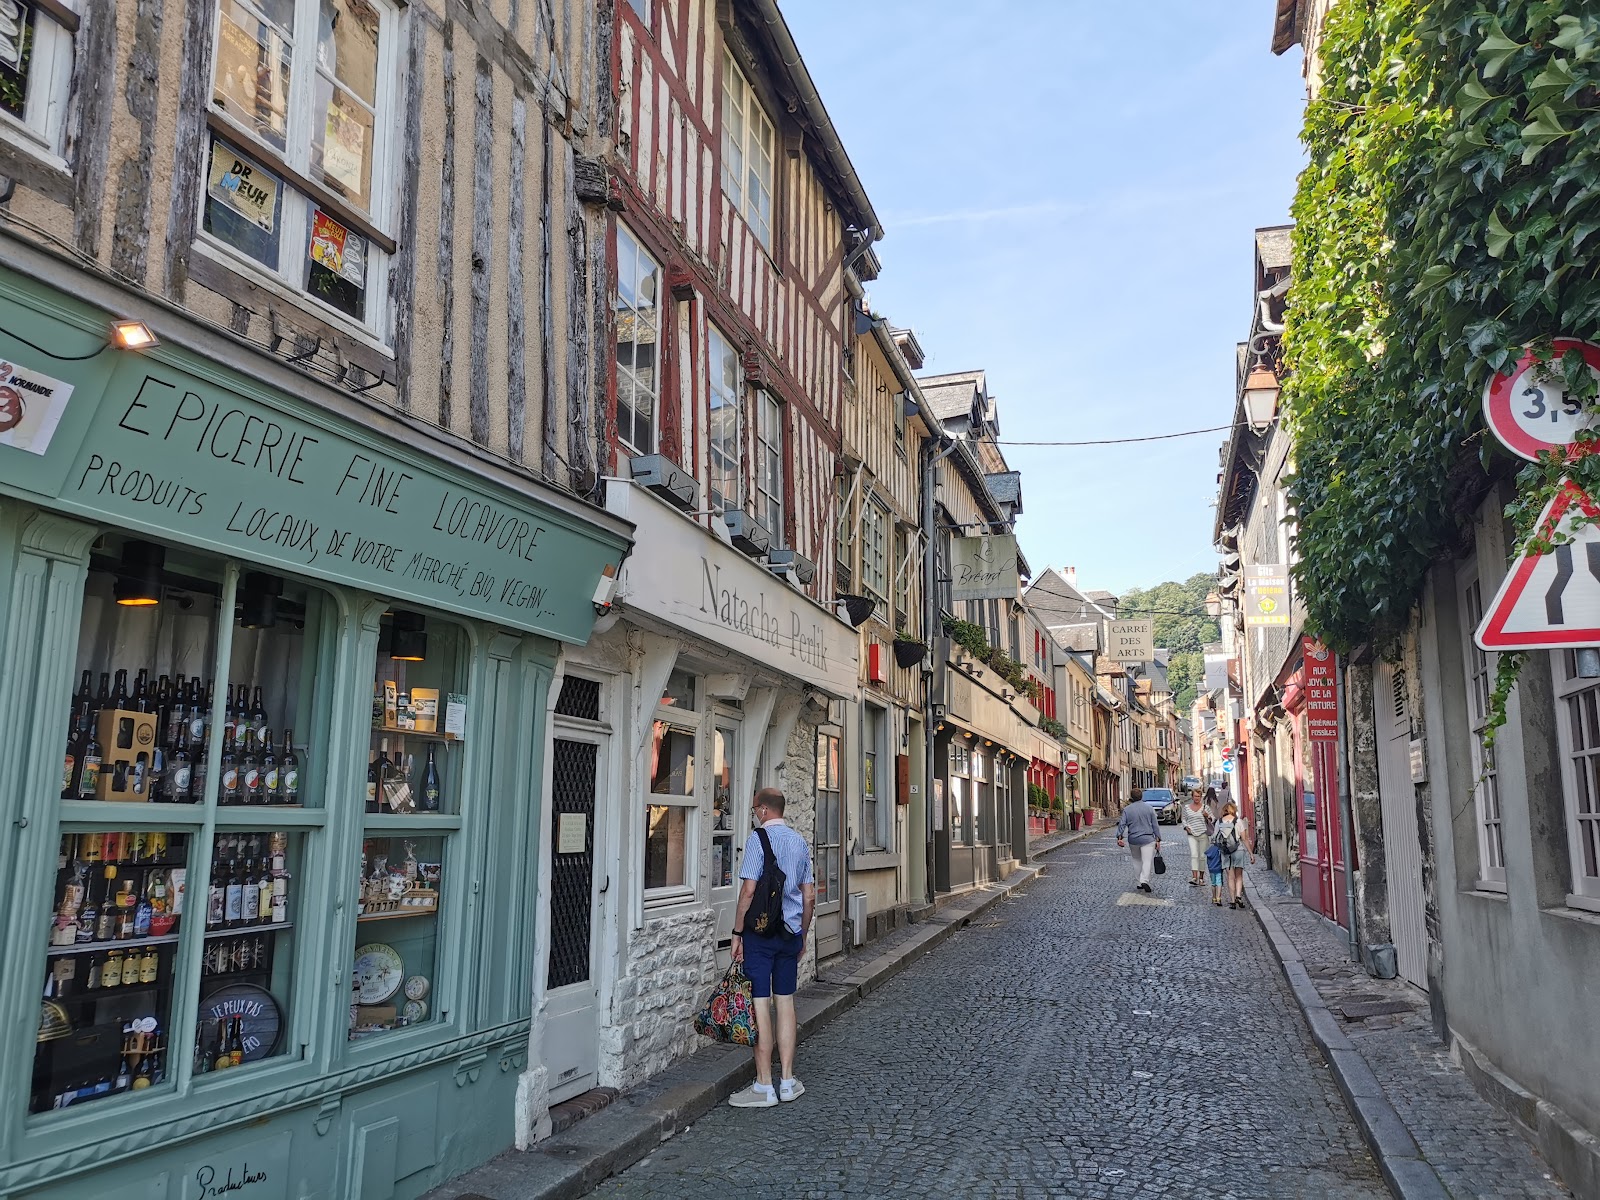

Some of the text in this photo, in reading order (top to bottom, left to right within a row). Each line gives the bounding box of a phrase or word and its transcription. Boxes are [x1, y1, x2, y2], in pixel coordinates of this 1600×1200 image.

[231, 160, 252, 179] DR
[220, 171, 268, 206] MEUH
[8, 375, 54, 398] NORMANDIE
[119, 375, 546, 562] EPICERIE FINE LOCAVORE
[226, 501, 320, 564] LOCAUX,
[326, 529, 351, 558] DE
[352, 537, 403, 573] VOTRE
[402, 552, 469, 597] MARCHÉ,
[973, 541, 995, 564] Le
[953, 558, 1016, 586] Bréard
[699, 556, 828, 673] Natacha Perlik
[1112, 624, 1148, 634] CARRÉ
[1120, 637, 1141, 646] DES
[1117, 649, 1145, 657] ARTS
[1312, 666, 1327, 675] AUX
[1311, 689, 1332, 698] DE LA
[1308, 701, 1336, 710] NATURE
[224, 1000, 245, 1015] PEUX
[245, 1000, 263, 1017] PAS
